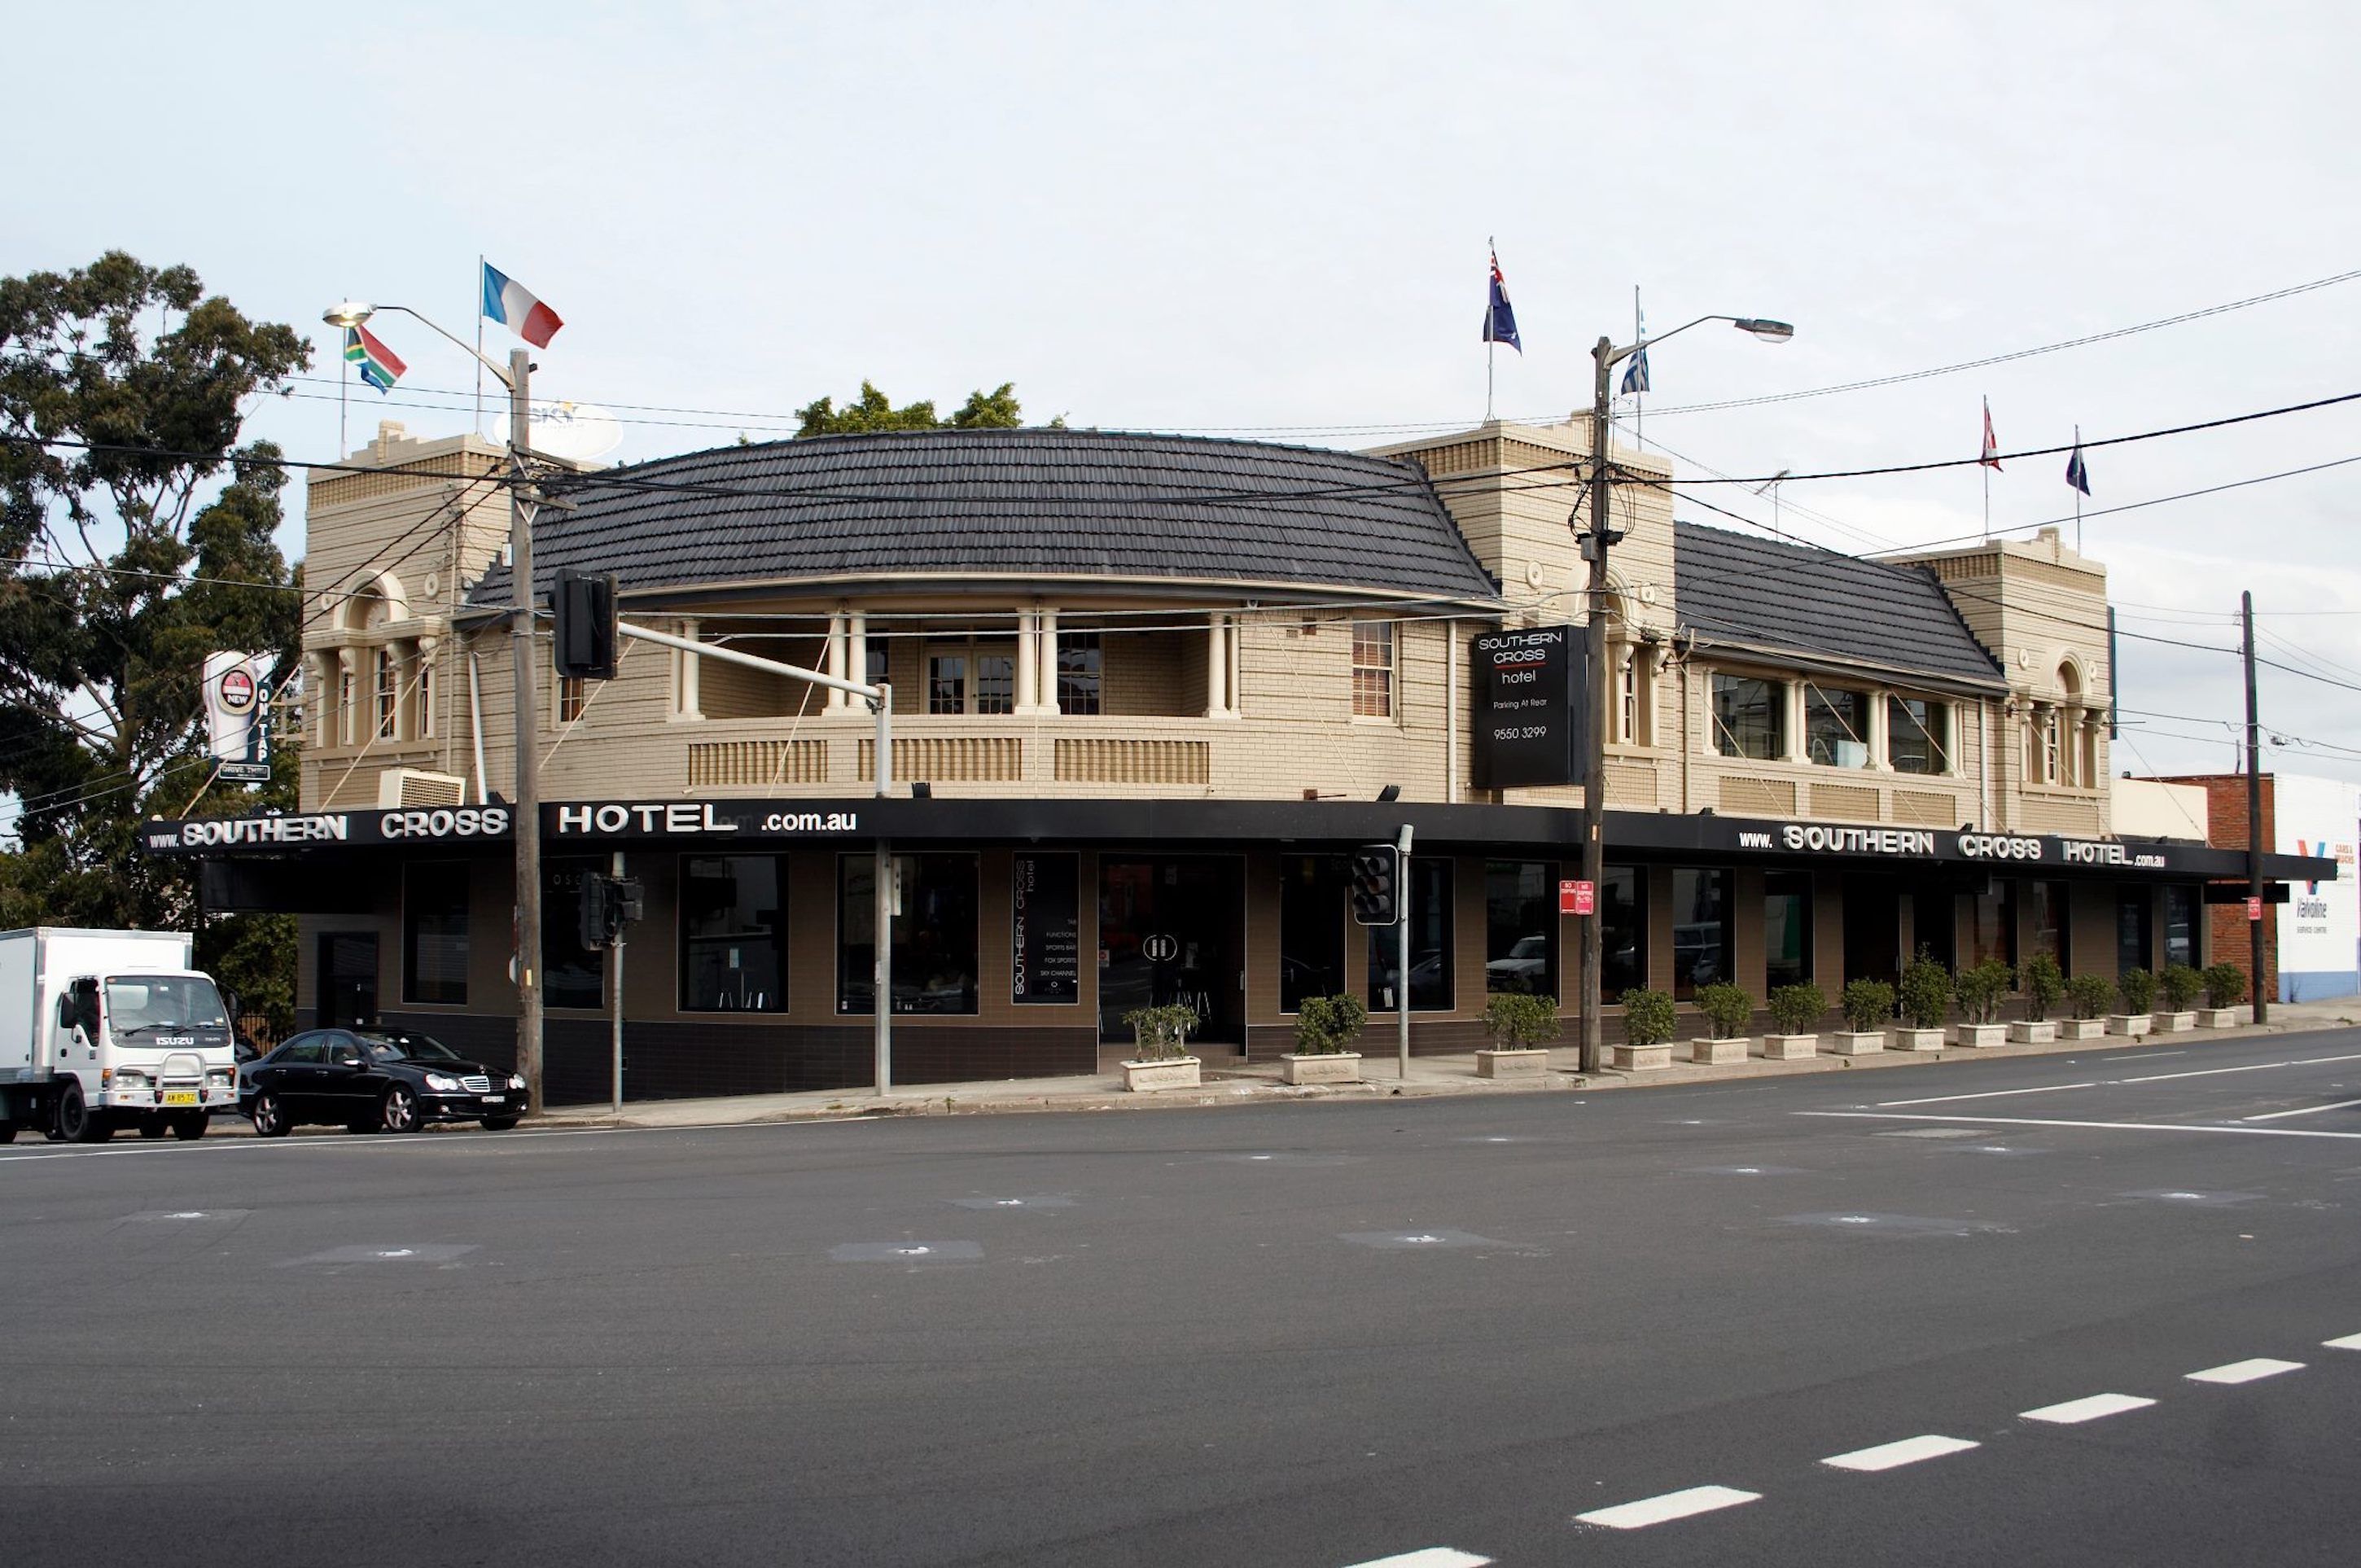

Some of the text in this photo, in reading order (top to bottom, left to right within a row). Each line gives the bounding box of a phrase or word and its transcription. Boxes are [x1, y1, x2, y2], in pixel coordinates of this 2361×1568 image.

[1478, 632, 1562, 650] SOUTHERN
[1493, 649, 1546, 664] CROSS
[1501, 669, 1536, 685] hotel
[227, 694, 249, 705] NEW
[1493, 698, 1547, 711] Parking At Rear
[1521, 725, 1547, 739] 3299
[257, 723, 269, 762] TAP
[149, 834, 179, 848] www.
[182, 815, 347, 848] SOUTHERN
[380, 808, 509, 839] CROSS
[558, 804, 738, 833] HOTEL
[760, 812, 856, 831] .com.au
[1739, 825, 2165, 869] www. SOUTHERN CROSS HOTEL .com.au
[1027, 860, 1035, 892] hotel
[1014, 860, 1025, 995] SOUTHERN CROSS
[156, 1036, 194, 1045] ISUZU
